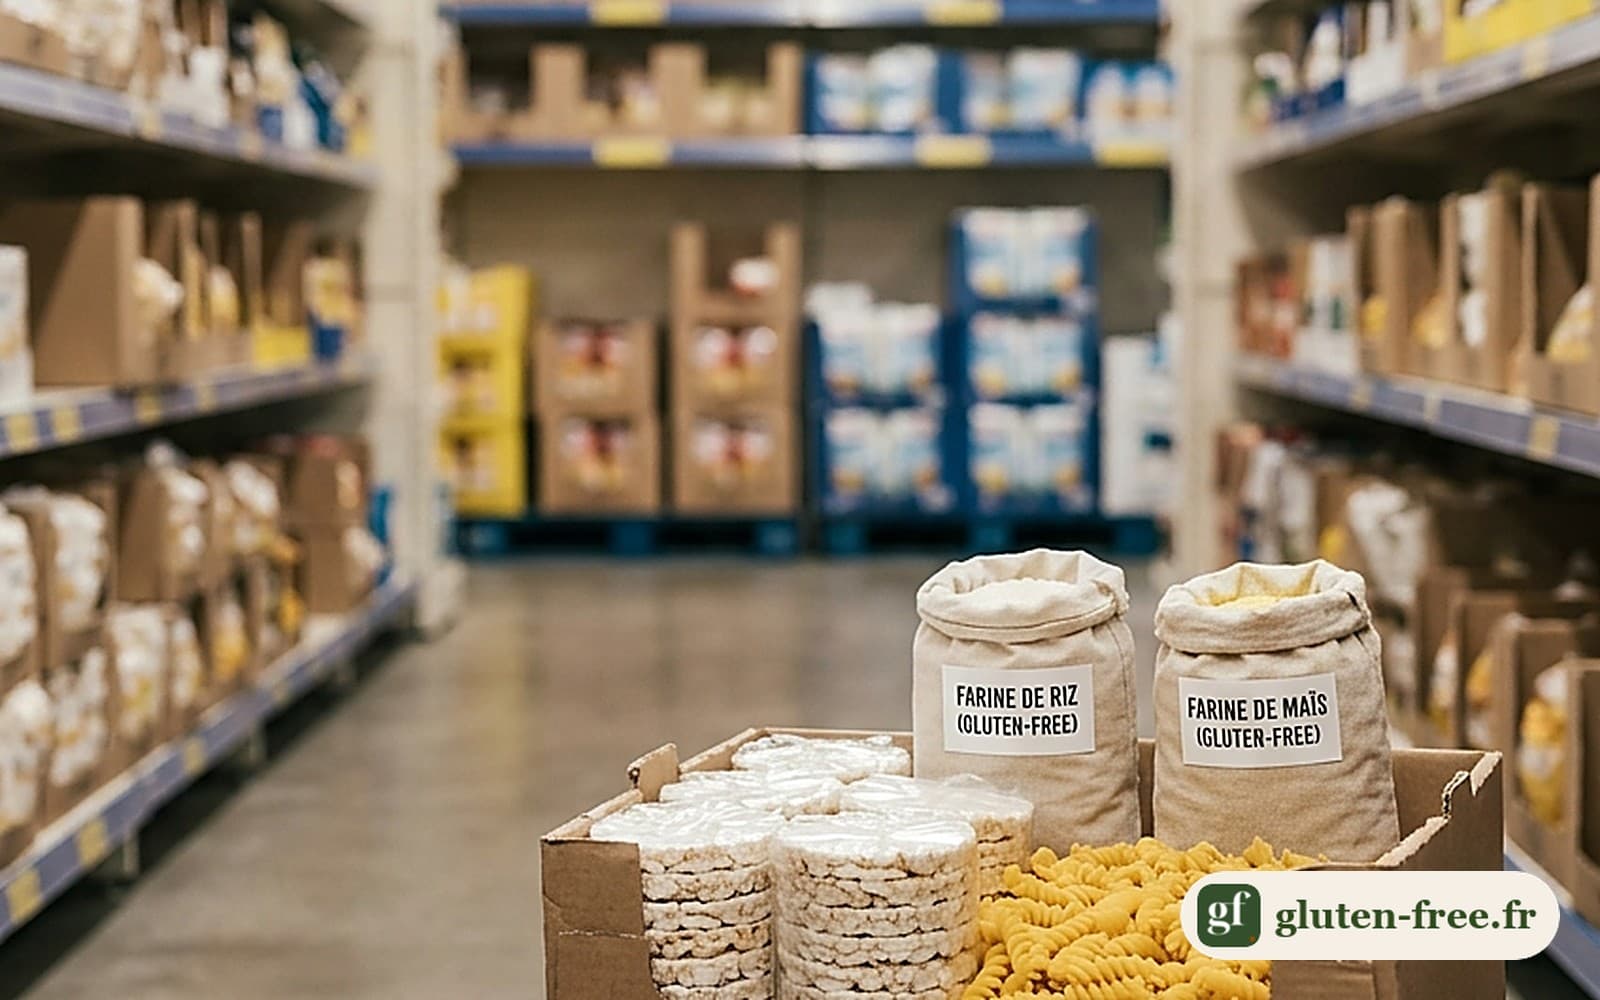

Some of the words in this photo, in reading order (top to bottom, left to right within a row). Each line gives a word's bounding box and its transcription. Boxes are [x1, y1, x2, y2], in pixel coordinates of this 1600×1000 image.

[956, 685, 1017, 709] FARINE
[1022, 687, 1045, 709] DE
[1050, 684, 1079, 708] RIZ
[1188, 696, 1249, 721] FARINE
[1253, 698, 1278, 721] DE
[1282, 690, 1328, 719] MAÏS
[957, 713, 1078, 737] (GLUTEN-FREE)
